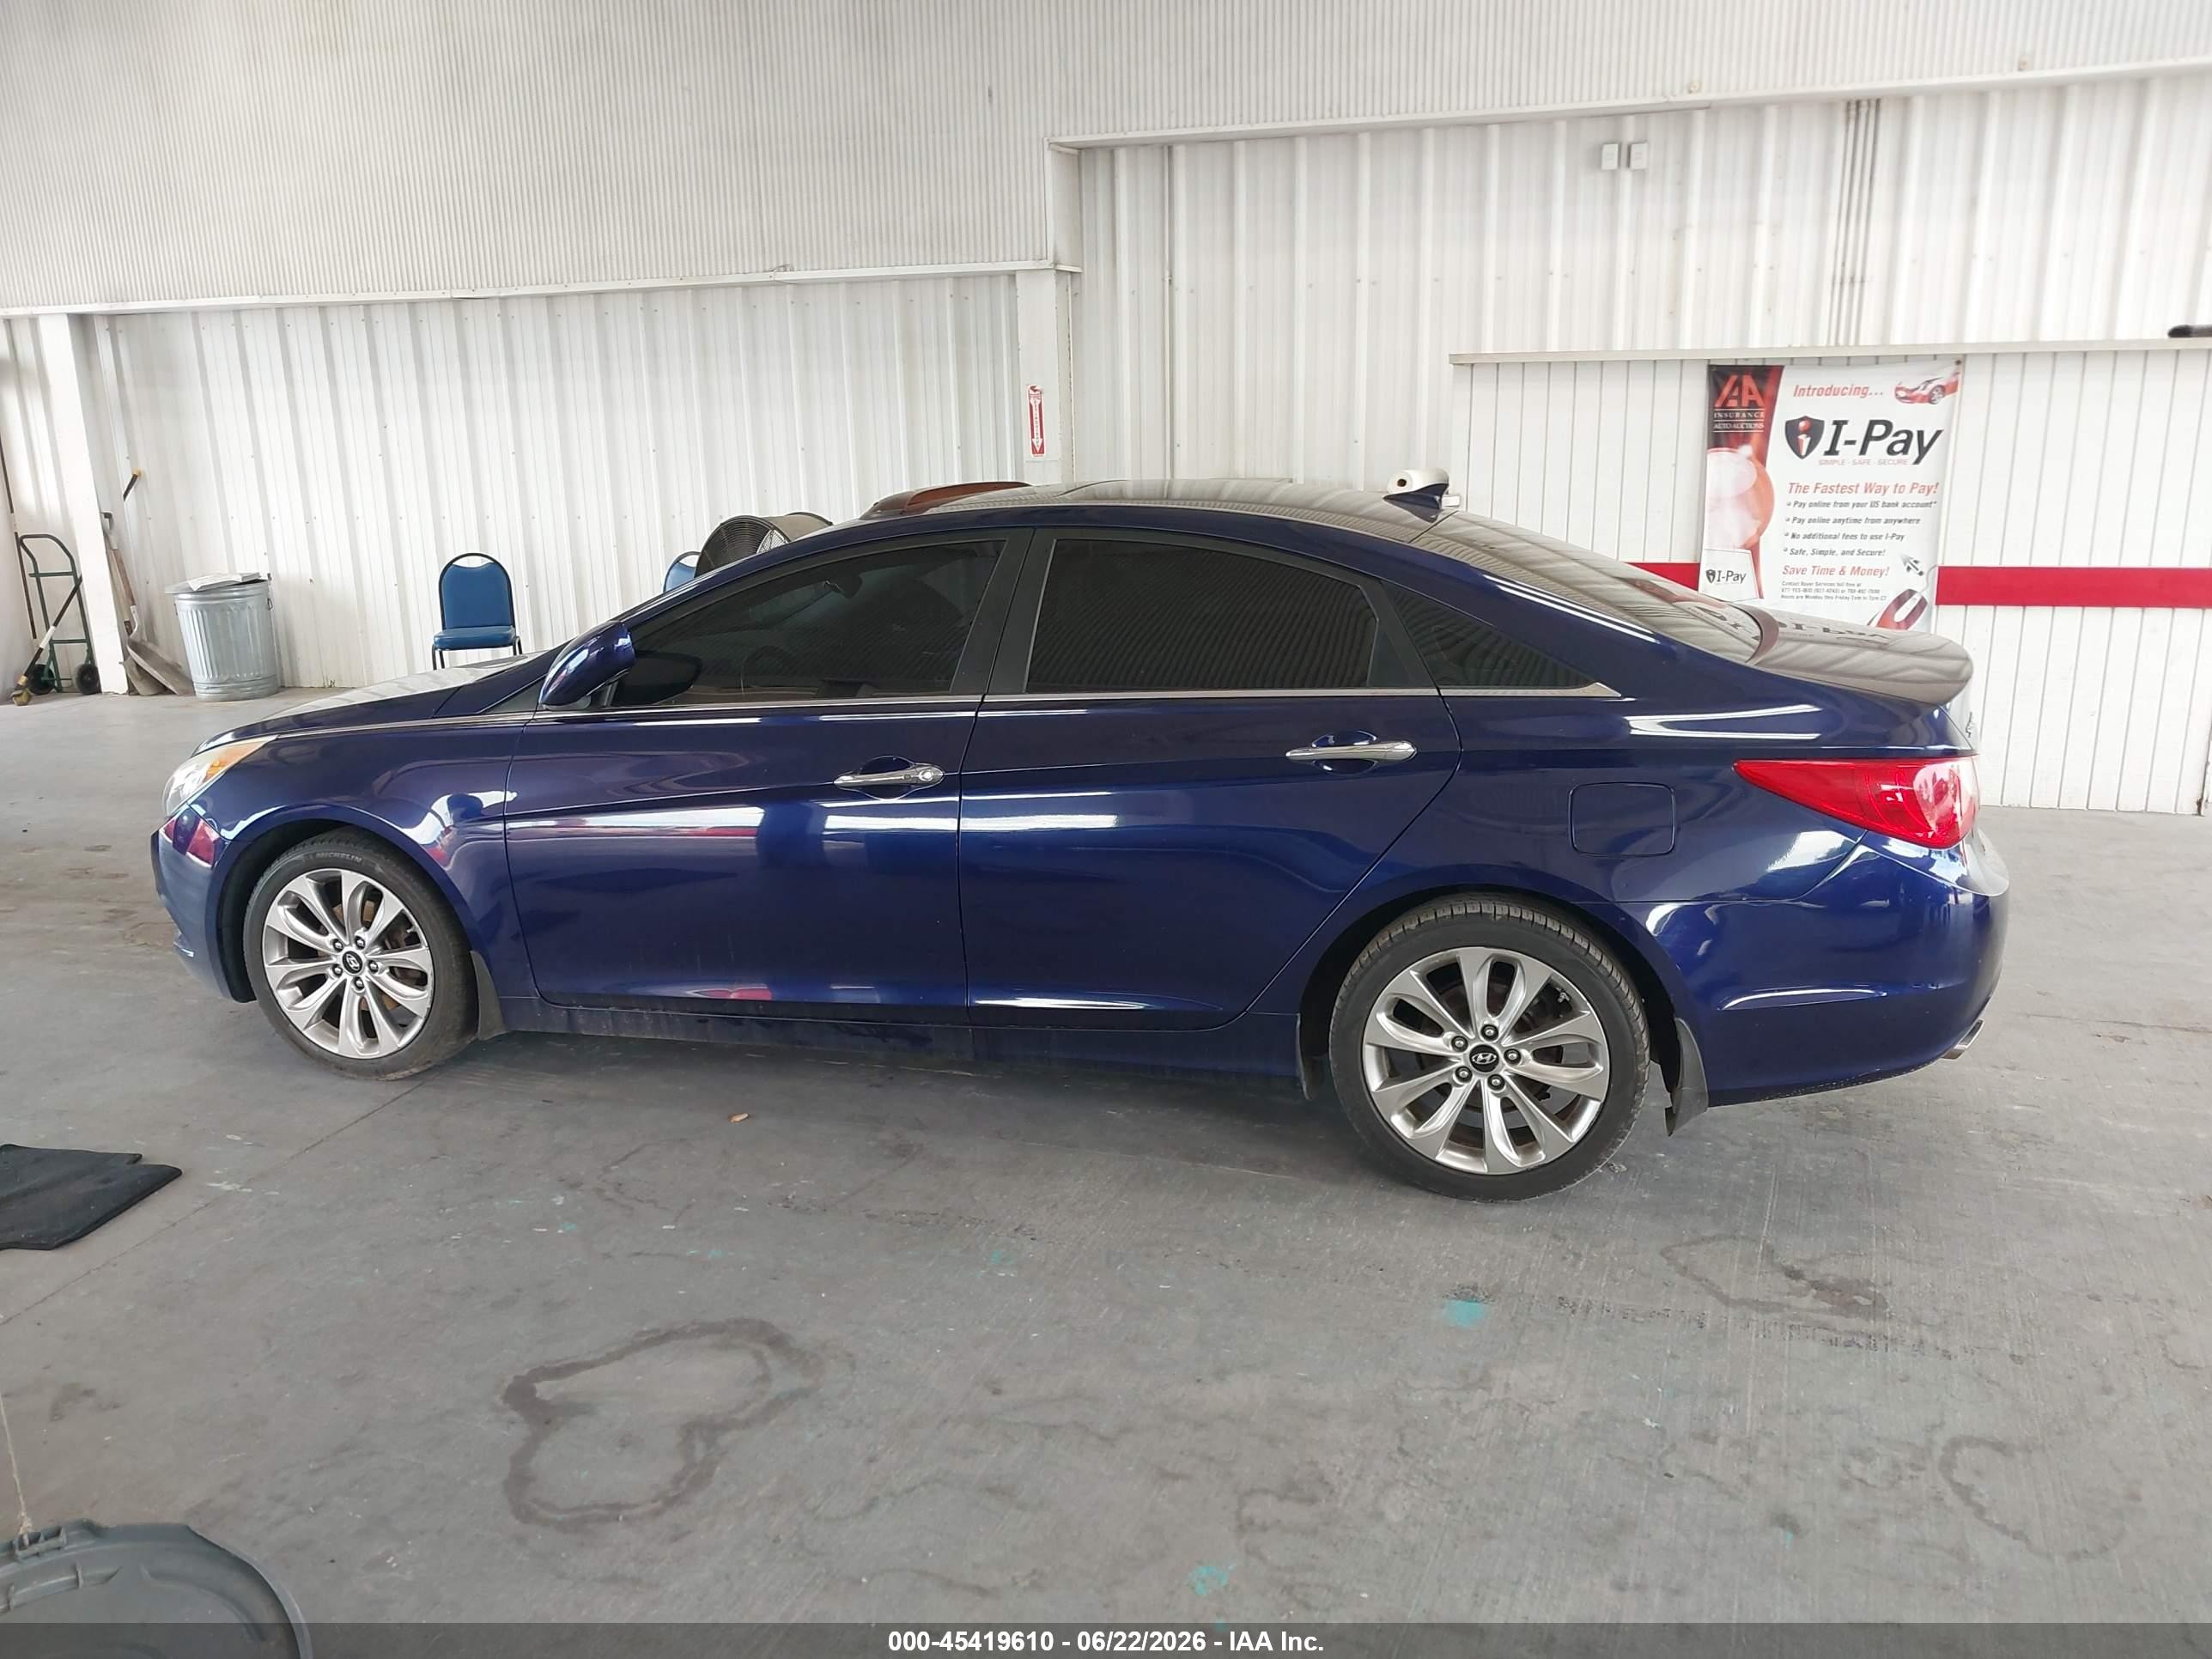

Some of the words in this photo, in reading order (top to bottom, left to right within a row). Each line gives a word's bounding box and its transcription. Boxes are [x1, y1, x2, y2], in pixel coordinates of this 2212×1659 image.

[1793, 385, 1883, 398] Introducing...
[1823, 419, 1944, 465] I-Pay
[1789, 483, 1809, 494] The
[1814, 483, 1860, 494] Fastest
[1863, 483, 1889, 496] Way
[1893, 483, 1905, 494] to
[1910, 482, 1939, 496] Pay!
[1883, 517, 1920, 526] anywhere
[1885, 533, 1905, 542] I-Pay
[1790, 548, 1808, 556] Safe,
[1810, 549, 1838, 557] Simple,
[1717, 570, 1747, 584] I-Pay
[1783, 565, 1808, 575] Save
[1811, 566, 1835, 575] Time
[1838, 567, 1845, 575] &
[1850, 567, 1889, 578] Money!
